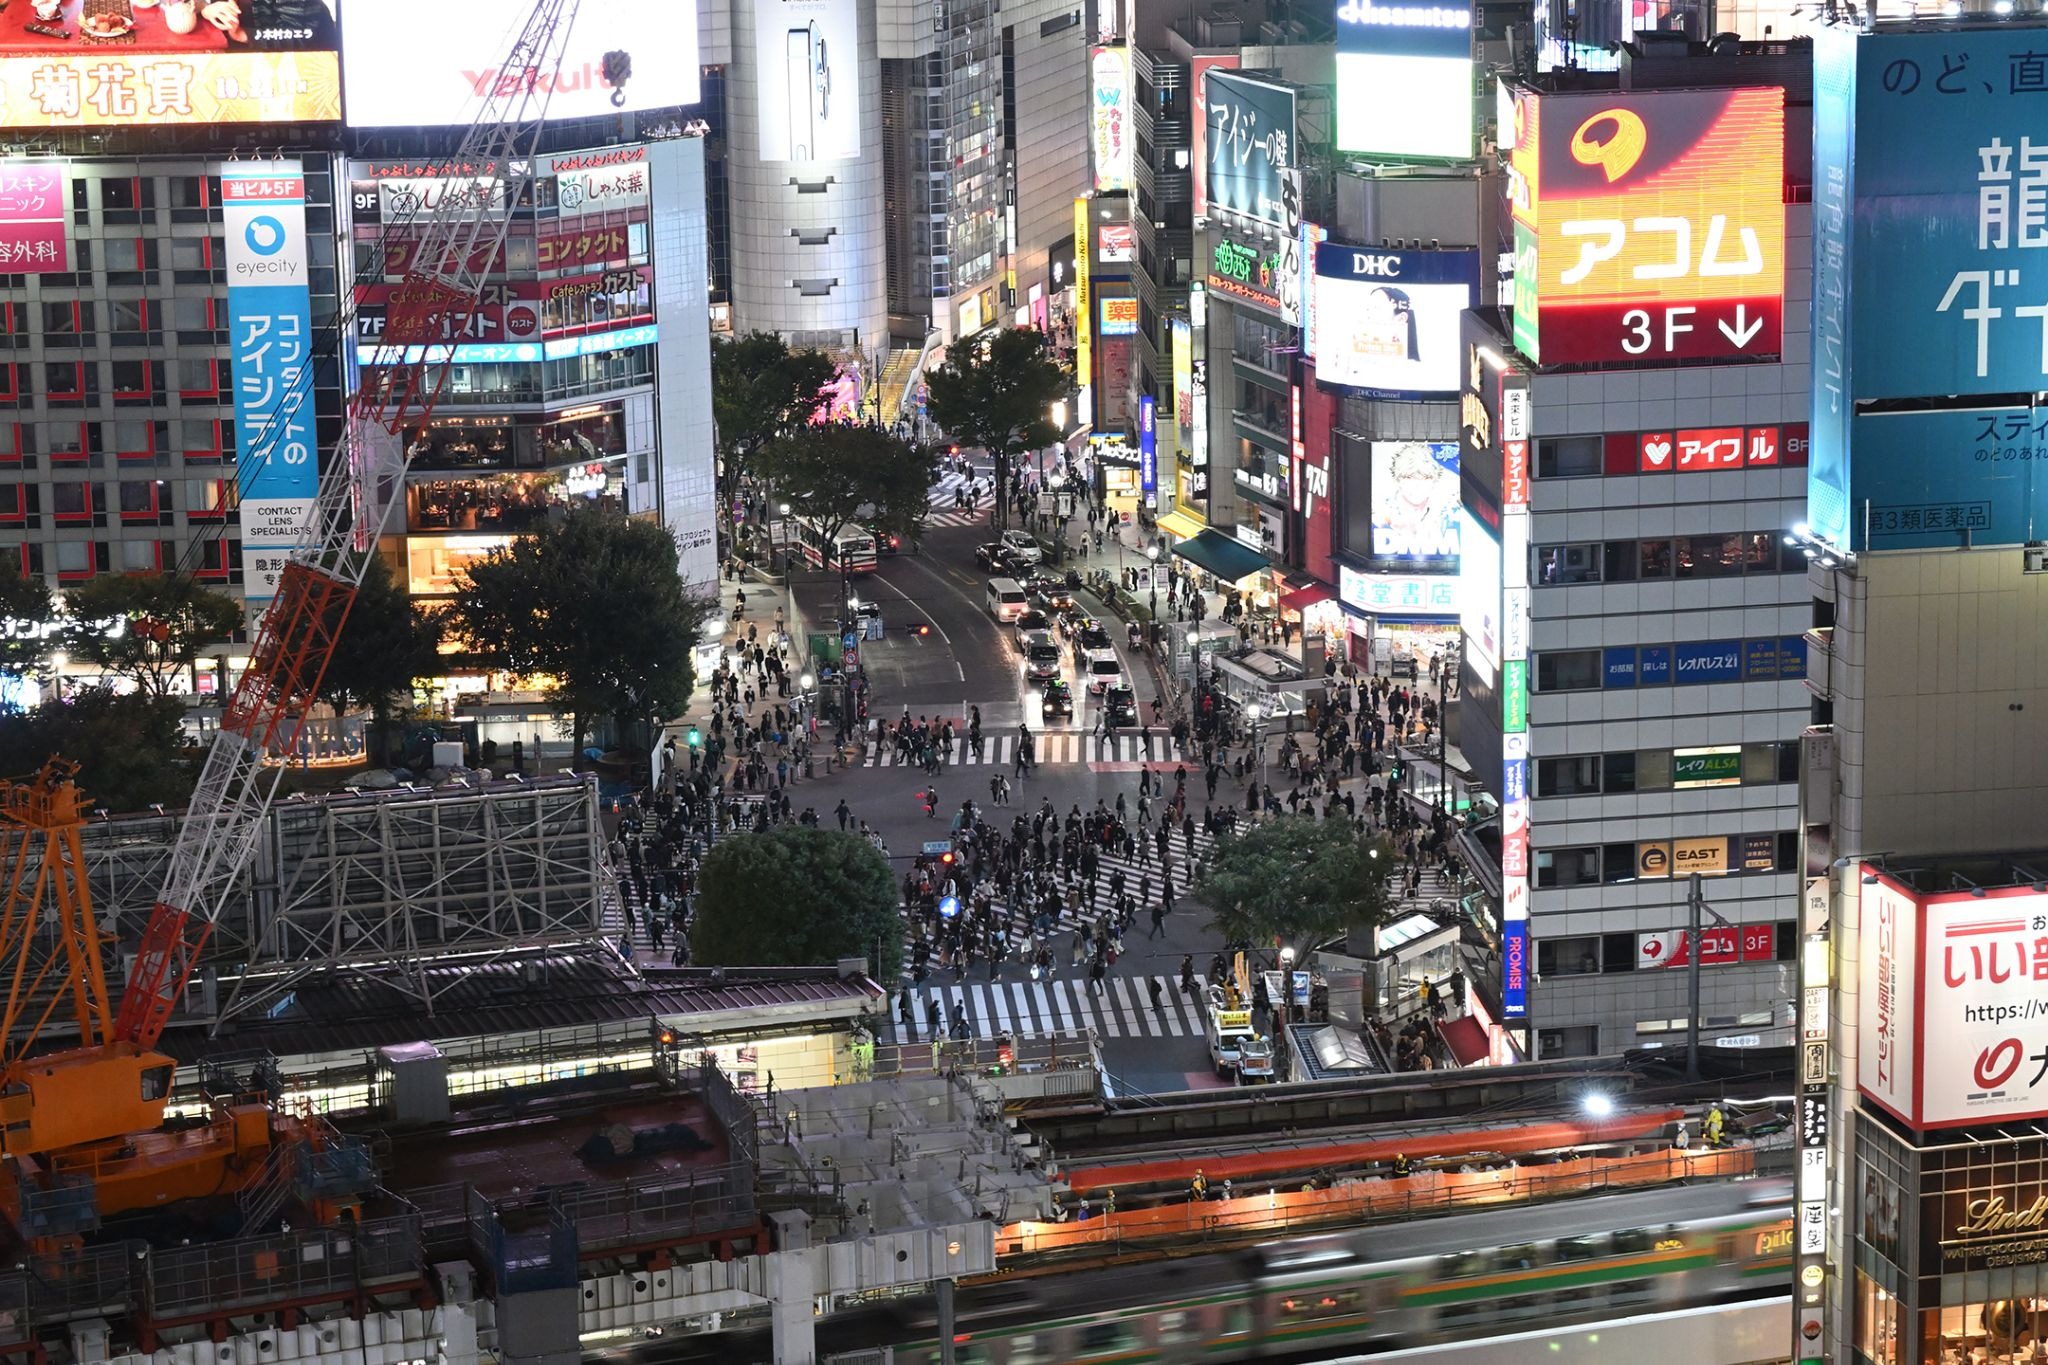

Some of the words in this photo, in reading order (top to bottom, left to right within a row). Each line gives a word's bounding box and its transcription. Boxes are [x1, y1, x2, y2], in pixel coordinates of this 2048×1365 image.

[1883, 50, 2048, 96] のど、直
[31, 62, 195, 117] 菊花賞
[1209, 102, 1288, 167] アイジーの壁
[551, 147, 646, 173] しゃぶしゃぶバイキング
[230, 182, 295, 197] 当ビル5F
[588, 170, 644, 200] しゃぶ葉
[354, 193, 377, 210] 9F
[0, 240, 58, 262] 容外科
[538, 231, 625, 263] コンタクト
[1561, 214, 1764, 285] アコム
[236, 258, 297, 277] eyecity
[1353, 253, 1401, 277] DHC
[604, 270, 645, 294] ガスト
[359, 317, 386, 335] 7F
[510, 319, 536, 328] ガスト
[1621, 306, 1697, 355] 3F
[239, 315, 276, 465] アイシティ
[278, 315, 307, 465] コンタクトの
[1679, 436, 1775, 465] アイフル
[1509, 456, 1523, 503] アイフル
[257, 506, 303, 517] CONTACT
[268, 516, 293, 527] LENS
[1867, 504, 1987, 530] 第3類医薬品
[250, 526, 312, 537] SPECIALISTS
[1609, 663, 1634, 674] お部屋
[1642, 661, 1667, 673] 探しは
[1678, 652, 1738, 672] レオパレス21
[1676, 848, 1720, 861] EAST
[2032, 915, 2046, 931] お
[1746, 935, 1769, 951] 3F
[1509, 936, 1522, 990] PROMISE
[1877, 896, 1891, 1088] いい部屋ネット
[1805, 1151, 1824, 1166] 3F
[1956, 1195, 2048, 1234] Lindt
[1986, 1254, 2023, 1267] DEPUIS
[2024, 1250, 2047, 1262] 1845
